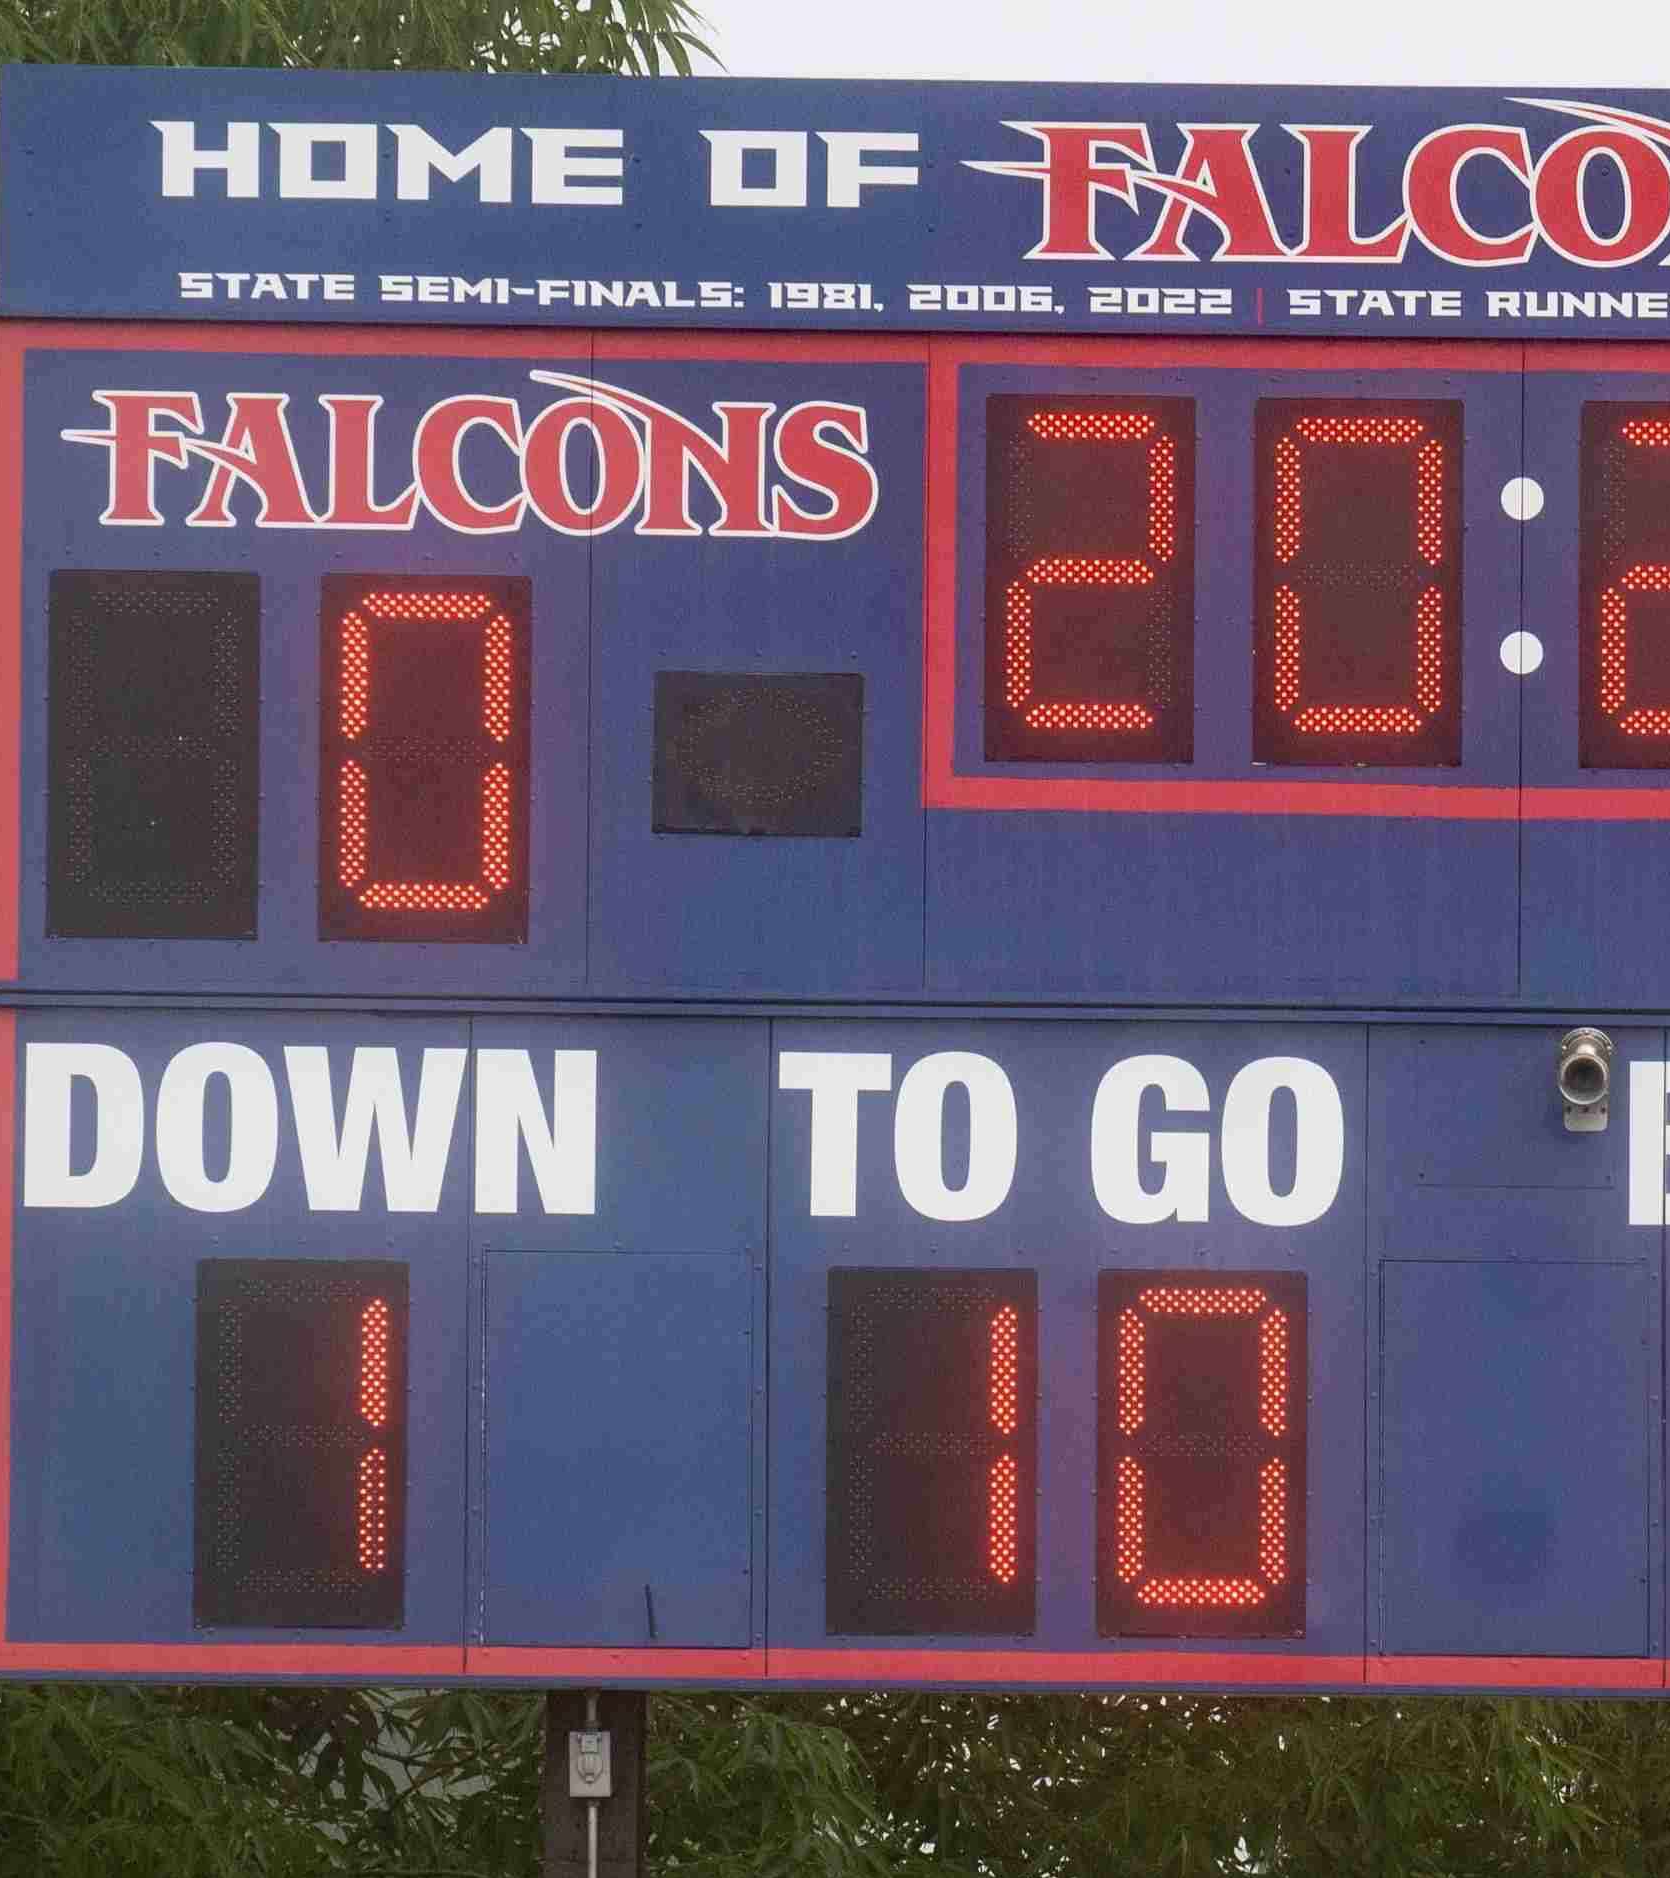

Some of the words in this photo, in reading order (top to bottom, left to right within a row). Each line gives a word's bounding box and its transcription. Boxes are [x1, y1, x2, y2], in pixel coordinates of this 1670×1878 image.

[151, 119, 625, 206] HOME
[704, 128, 923, 210] OF
[178, 271, 356, 301] STATE
[377, 273, 746, 309] SEMI-FINALS:
[766, 281, 886, 313] 1981,
[905, 283, 1066, 314] 2006,
[1086, 286, 1233, 315] 2022
[1287, 288, 1463, 319] STATE
[61, 369, 880, 541] FALCONS
[338, 590, 516, 914] 0
[23, 1040, 600, 1215] DOWN
[777, 1050, 1020, 1222] TO
[1090, 1053, 1346, 1228] GO
[354, 1296, 392, 1574] 1
[986, 1284, 1291, 1610] 10
